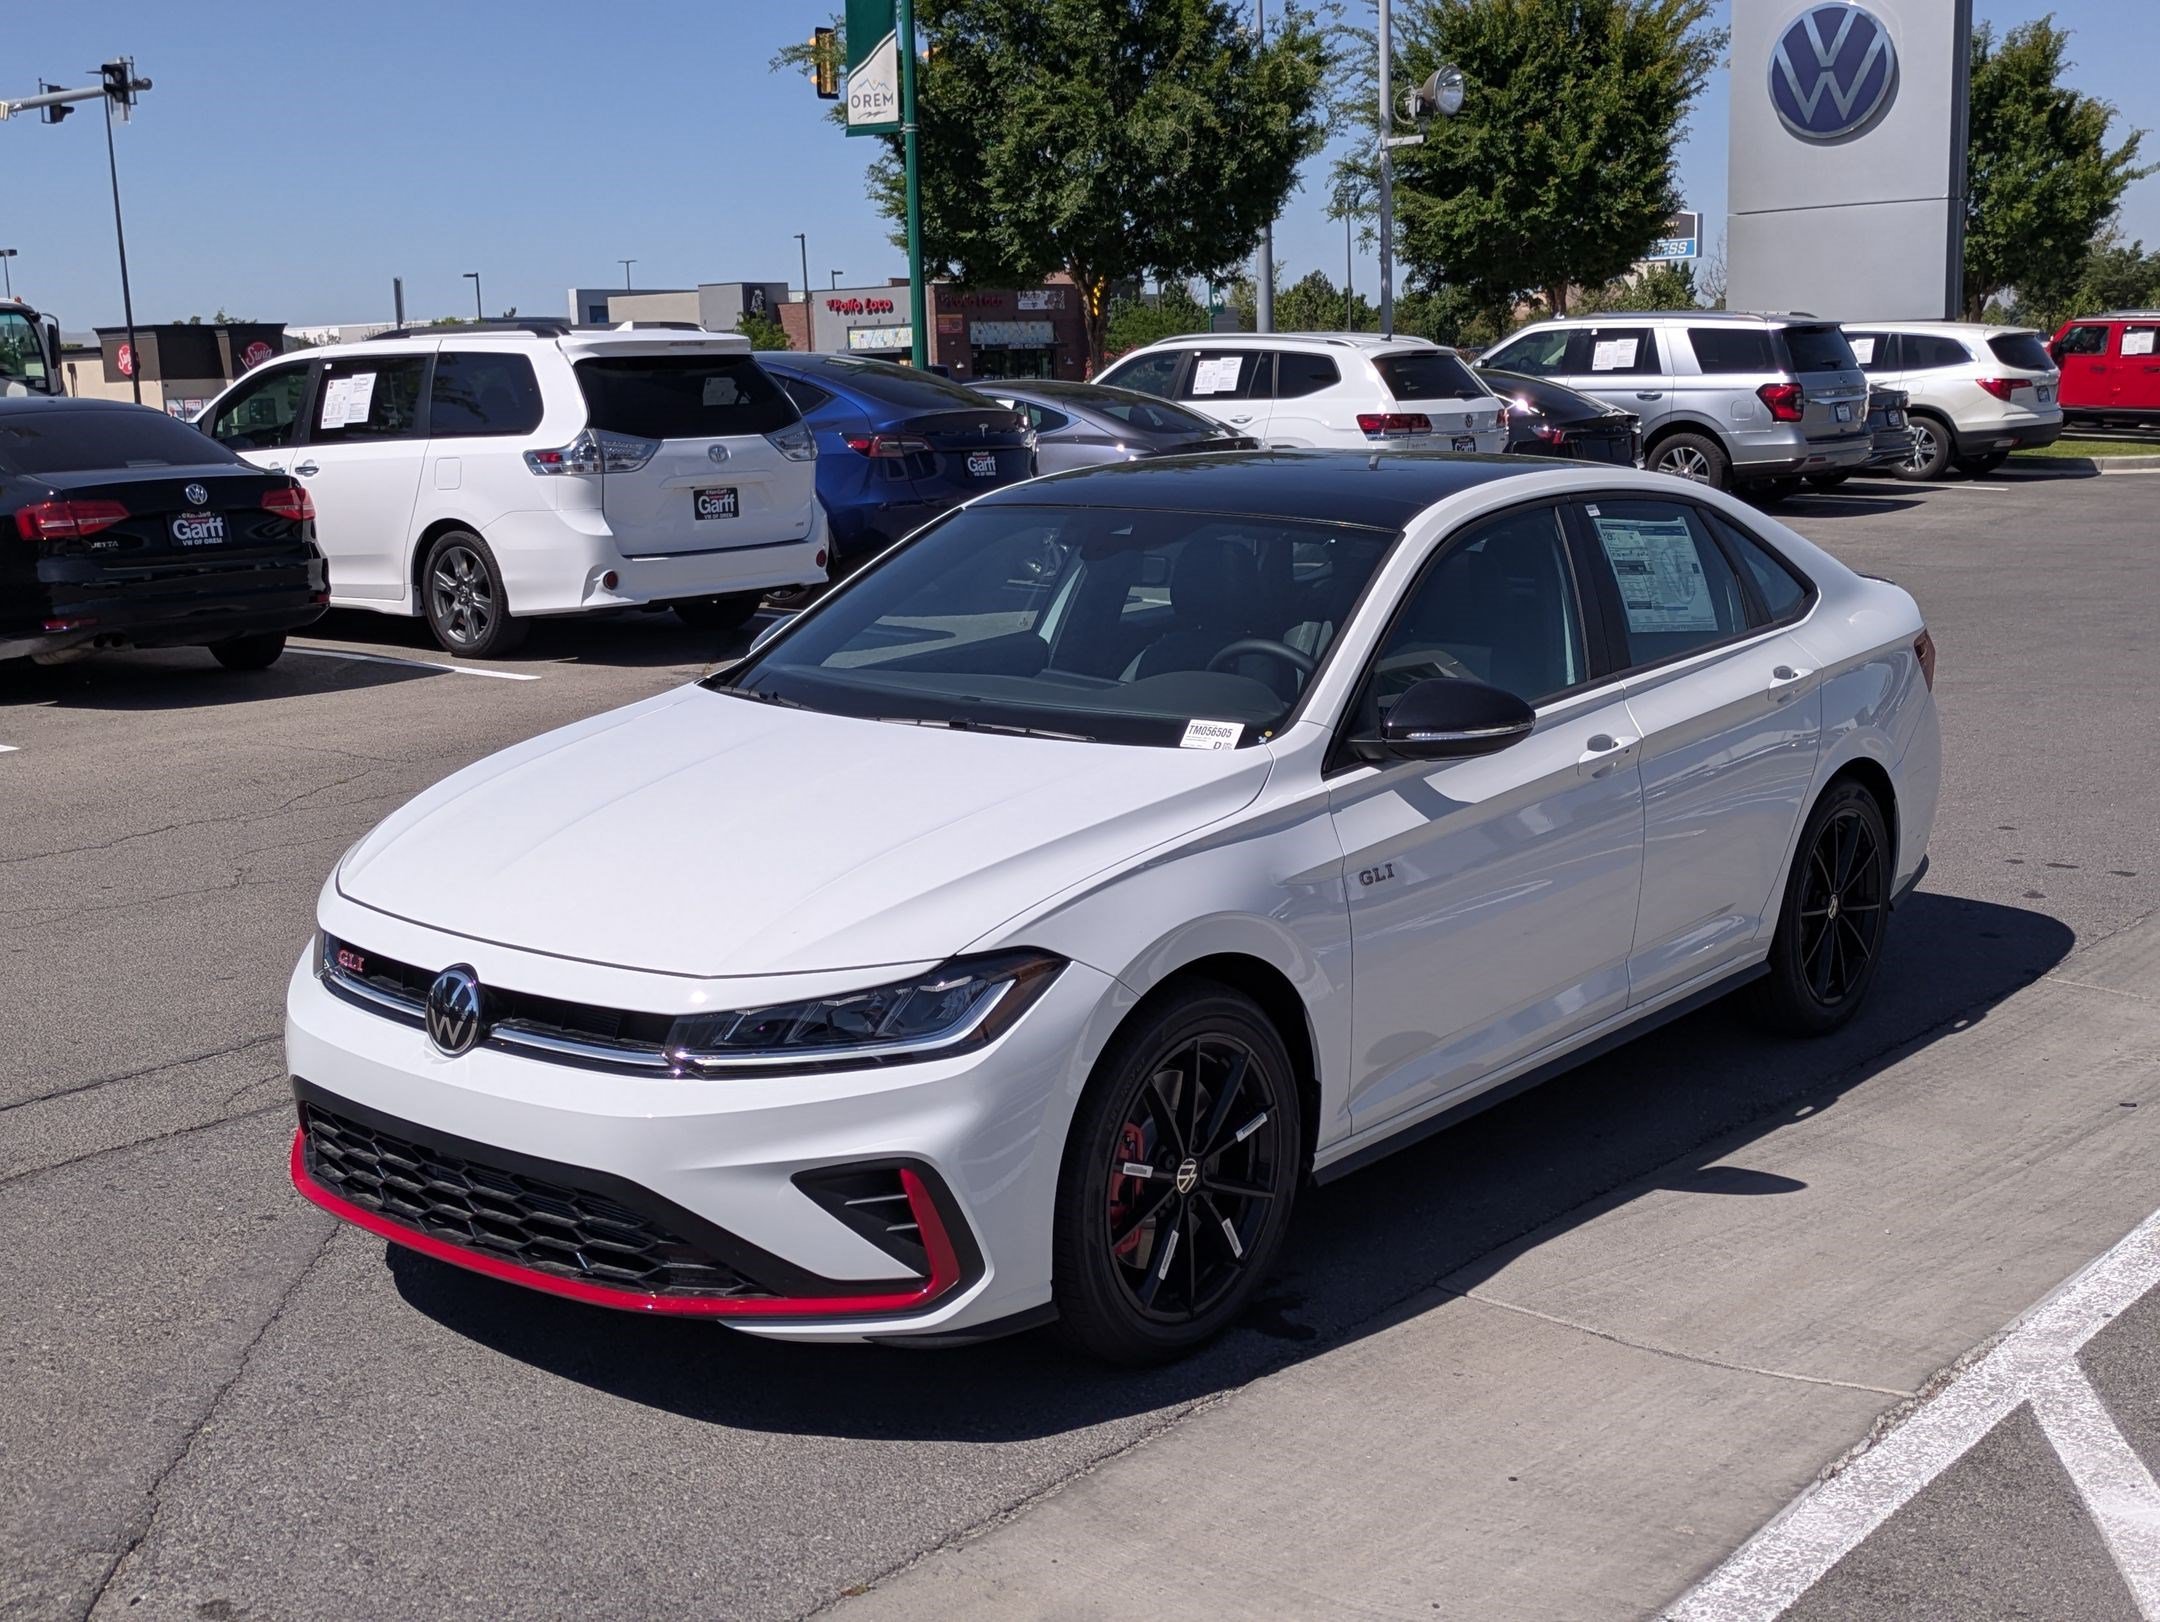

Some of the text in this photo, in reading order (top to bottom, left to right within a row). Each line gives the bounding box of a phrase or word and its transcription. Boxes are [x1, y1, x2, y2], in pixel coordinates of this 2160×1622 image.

[851, 92, 894, 108] OREM
[1656, 241, 1688, 256] ESS
[834, 298, 860, 311] Pollo
[863, 298, 891, 311] Loco
[967, 456, 996, 472] Garff
[698, 494, 735, 514] Garff
[172, 516, 224, 540] Garff
[91, 540, 119, 549] JETTA
[1188, 725, 1233, 738] TM056505
[1213, 741, 1222, 750] D
[1359, 863, 1395, 886] GLI
[338, 950, 365, 973] GLI
